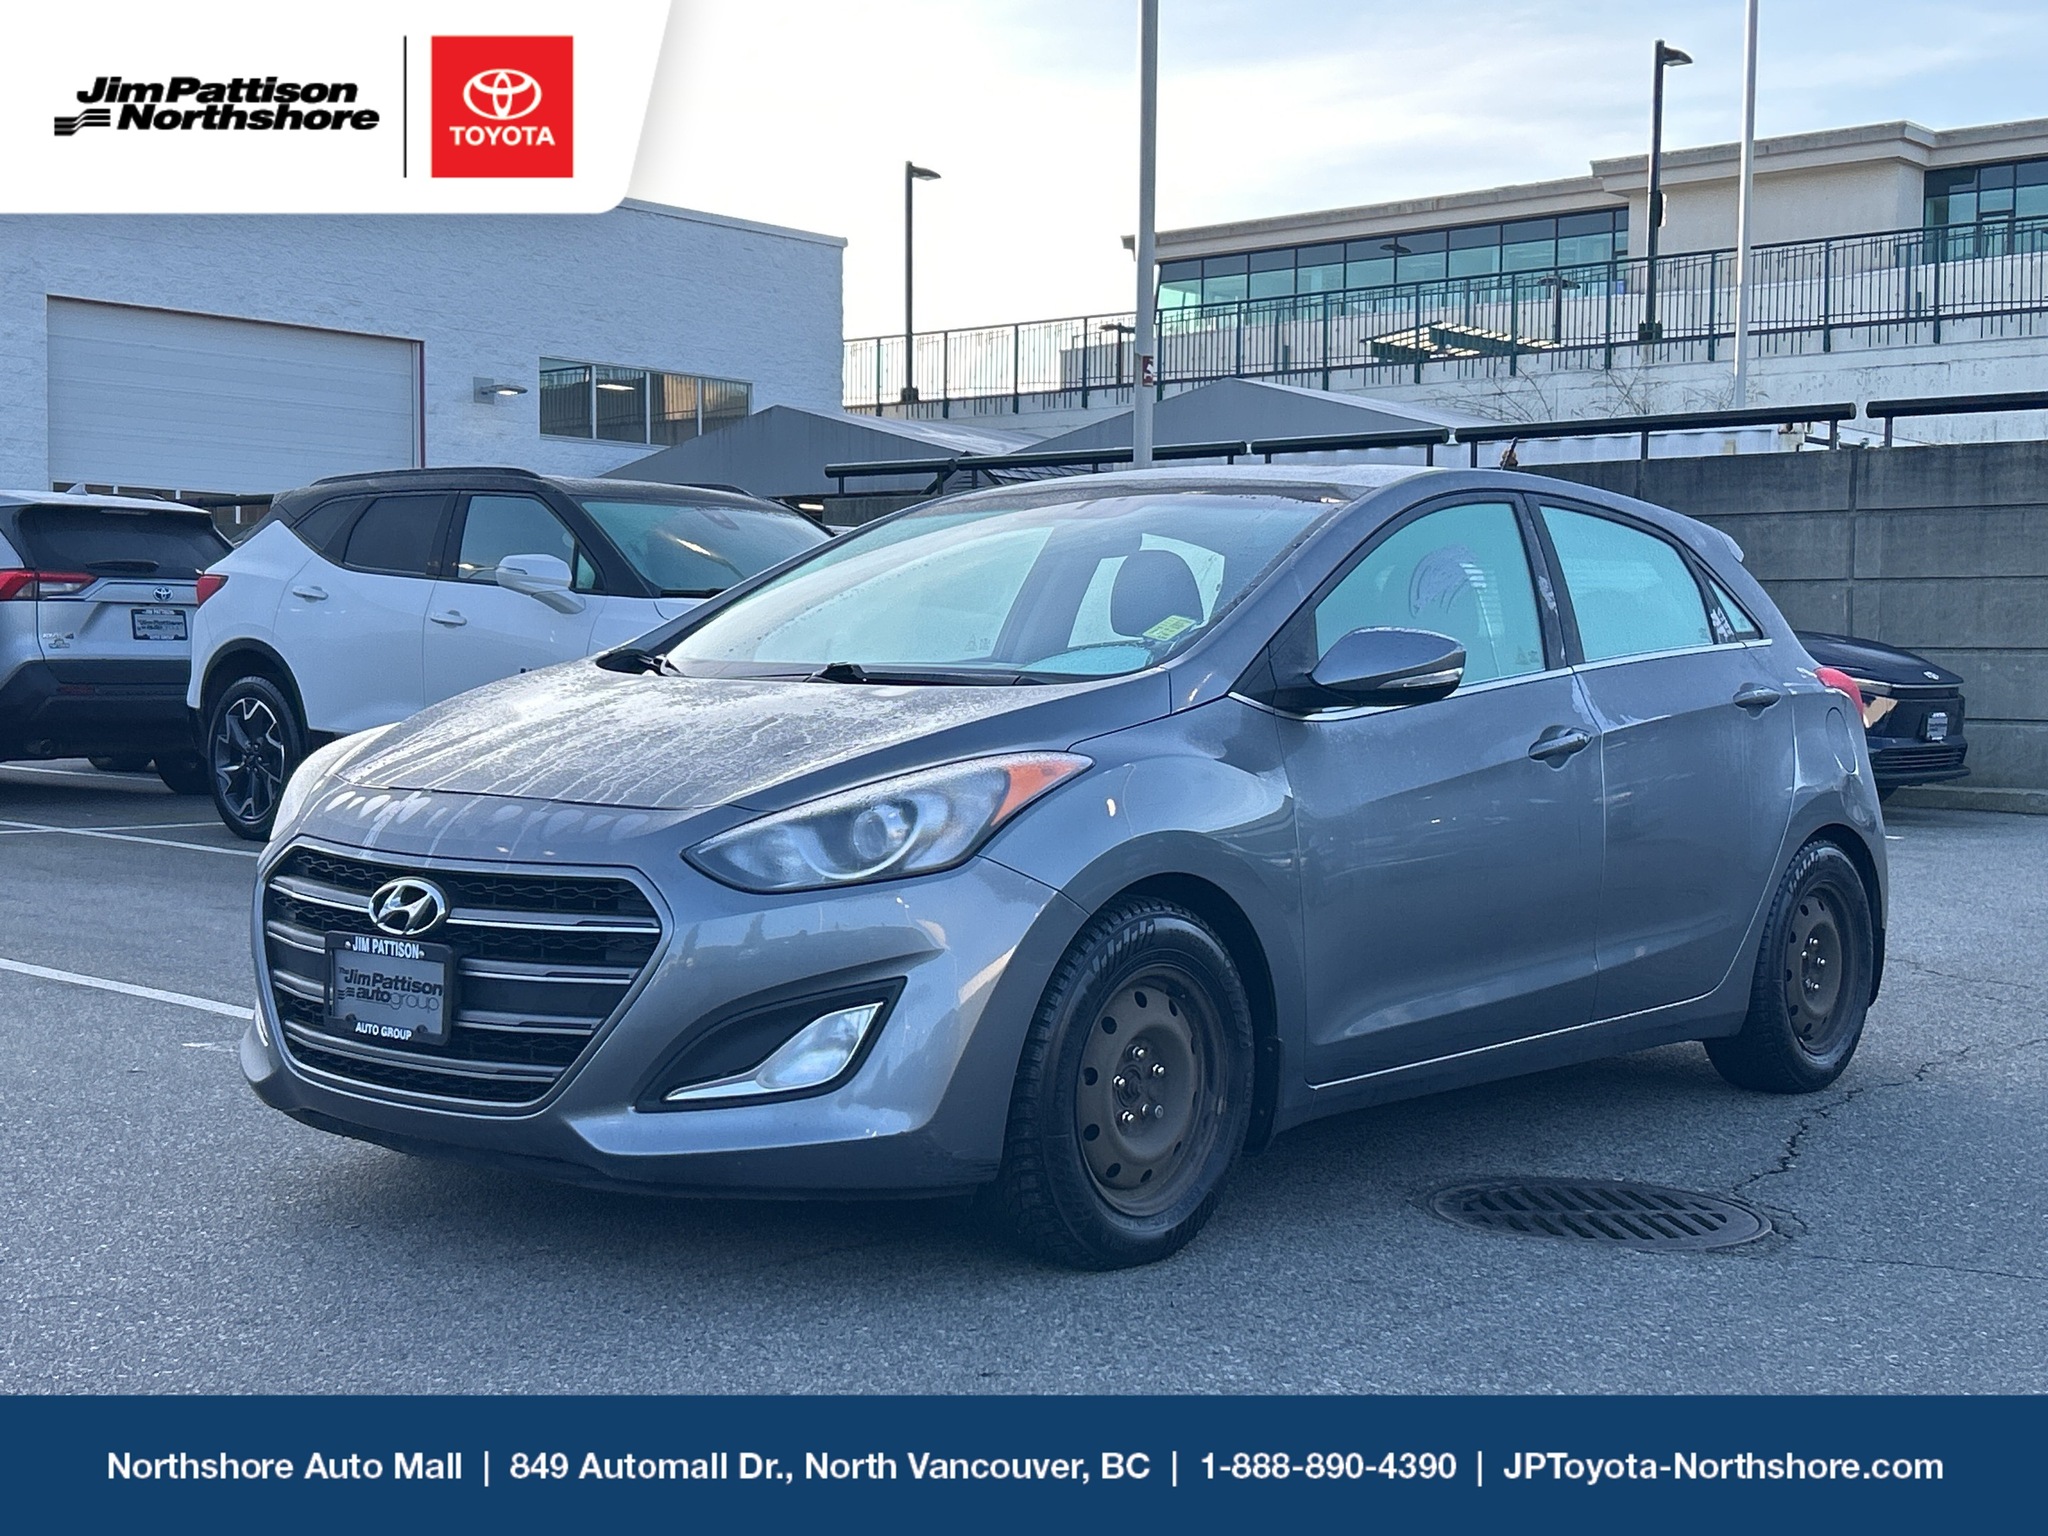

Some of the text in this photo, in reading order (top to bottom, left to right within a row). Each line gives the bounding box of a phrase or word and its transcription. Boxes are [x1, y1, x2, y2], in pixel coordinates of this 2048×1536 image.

[352, 936, 420, 959] JIM PATTISON
[355, 1022, 412, 1041] AUTO GROUP
